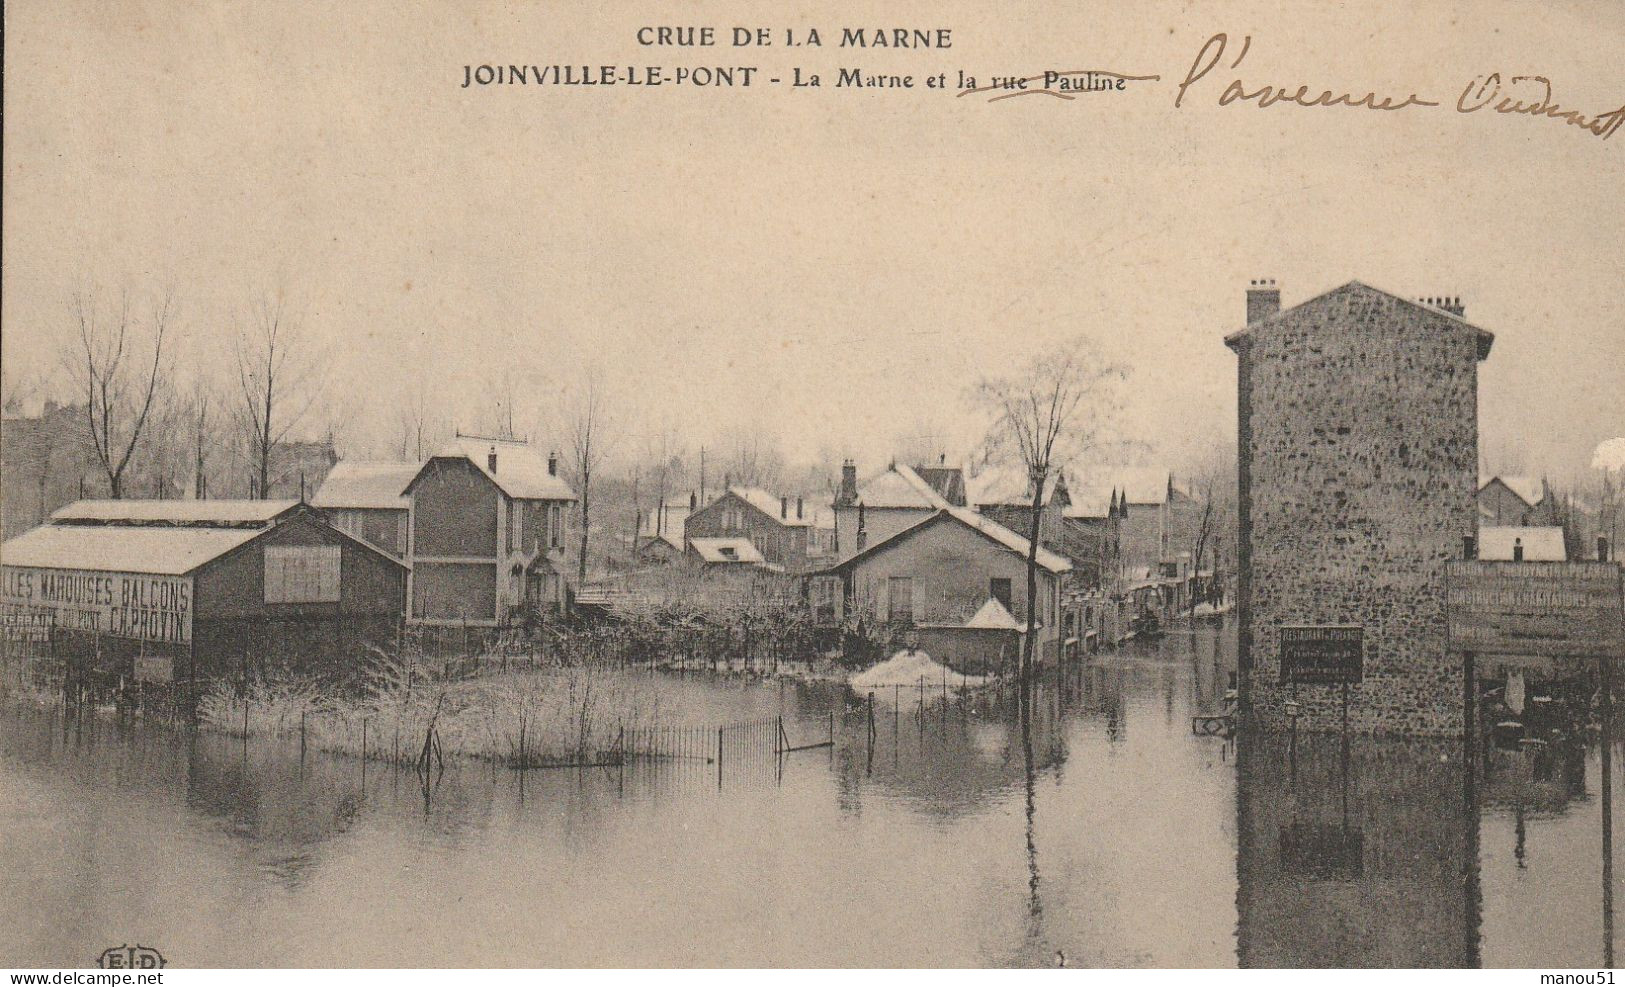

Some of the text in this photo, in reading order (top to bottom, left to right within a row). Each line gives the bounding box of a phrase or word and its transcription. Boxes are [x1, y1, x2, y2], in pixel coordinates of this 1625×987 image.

[637, 27, 952, 49] CRUE DE LA MARNE
[461, 65, 758, 89] JOINVILLE-LE-PONT
[792, 67, 821, 87] La
[835, 68, 914, 89] Marne
[926, 72, 946, 89] et
[958, 70, 977, 89] la
[991, 76, 1028, 90] rue
[1044, 70, 1127, 91] Pauline
[40, 573, 113, 606] MARQUISES
[121, 578, 188, 612] BALCONS
